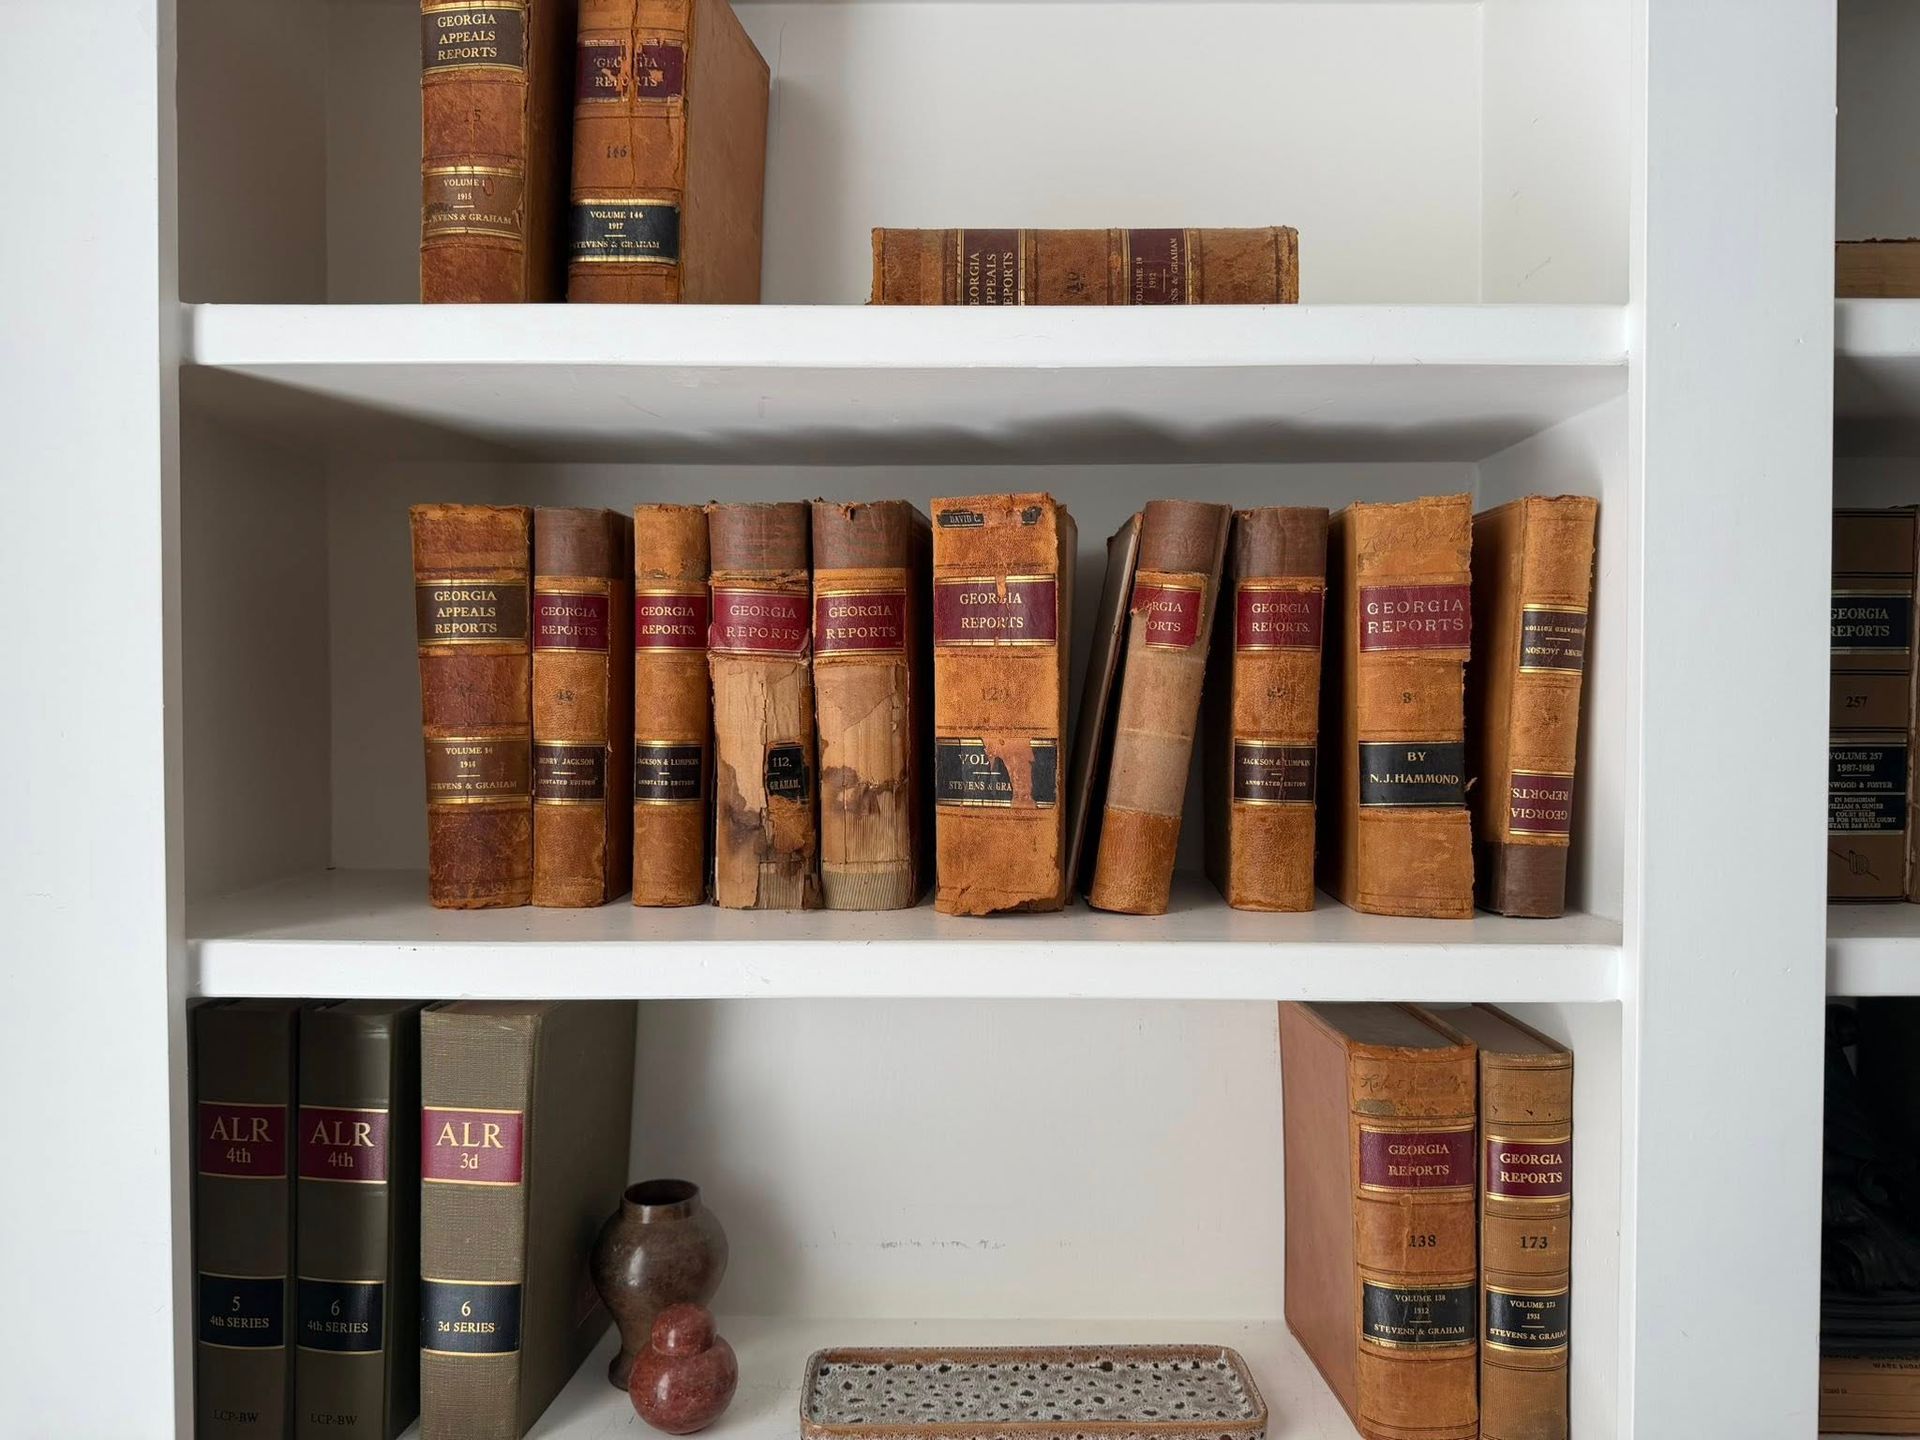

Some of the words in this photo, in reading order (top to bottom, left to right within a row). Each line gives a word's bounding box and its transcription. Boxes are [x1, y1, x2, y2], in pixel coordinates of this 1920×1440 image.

[437, 14, 497, 28] GEORGIA
[438, 30, 496, 45] APPEALS
[437, 46, 497, 61] REPORTS
[443, 178, 480, 187] VOLUME
[459, 213, 467, 221] &
[468, 213, 512, 225] GRAHAM
[590, 210, 626, 219] VOLUME
[621, 241, 660, 249] GRAHAM
[969, 252, 981, 305] EORGIA
[986, 252, 998, 305] PPEALS
[1003, 252, 1014, 305] EPORTS
[950, 515, 972, 523] DAVID
[434, 590, 498, 602] GEORGIA
[437, 607, 496, 617] APPEALS
[541, 606, 598, 618] GEORGIA
[641, 606, 695, 617] GEORGIA
[729, 605, 797, 619] GEORGIA
[828, 605, 892, 618] GEORGIA
[1251, 603, 1310, 615] GEORGIA
[1366, 599, 1464, 615] GEORGIA
[1831, 608, 1889, 620] GEORGIA
[434, 622, 498, 634] REPORTS
[961, 617, 1024, 629] REPORTS
[1367, 618, 1464, 634] REPORTS
[541, 625, 598, 637] REPORTS
[726, 626, 800, 640] REPORTS
[825, 626, 897, 640] REPORTS
[1830, 625, 1890, 637] REPORTS
[1525, 646, 1560, 655] JACKSON
[1846, 696, 1868, 708] 257
[445, 747, 483, 755] VOLUME
[1406, 752, 1427, 762] BY
[562, 758, 595, 766] JACKSON
[663, 757, 669, 765] &
[1243, 757, 1274, 766] JACKSON
[465, 782, 473, 790] &
[475, 780, 517, 790] GRAHAM
[949, 780, 985, 790] STEVENS
[1511, 807, 1569, 820] GEORGIA
[210, 1116, 273, 1143] ALR
[310, 1122, 375, 1148] ALR
[436, 1121, 503, 1149] ALR
[1388, 1144, 1450, 1155] GEORGIA
[226, 1149, 251, 1165] 4th
[327, 1151, 354, 1168] 4th
[460, 1153, 479, 1169] 3d
[1500, 1152, 1563, 1165] GEORGIA
[1388, 1164, 1450, 1176] REPORTS
[1500, 1171, 1563, 1184] REPORTS
[1408, 1235, 1437, 1248] 138
[1520, 1236, 1548, 1249] 173
[232, 1296, 241, 1312] 5
[1395, 1294, 1432, 1303] VOLUME
[1510, 1300, 1544, 1309] VOLUME
[330, 1300, 340, 1316] 6
[461, 1300, 472, 1316] 6
[209, 1315, 225, 1328] 4th
[226, 1317, 270, 1329] SERIES
[307, 1320, 323, 1332] 4th
[325, 1321, 369, 1334] SERIES
[438, 1321, 451, 1332] 3d
[453, 1321, 496, 1333] SERIES
[1373, 1324, 1415, 1336] STEVENS
[1417, 1327, 1425, 1335] &
[1427, 1326, 1465, 1335] GRAHAM
[1490, 1328, 1528, 1340] STEVENS
[1529, 1331, 1537, 1340] &
[1538, 1330, 1567, 1340] GRAHAM
